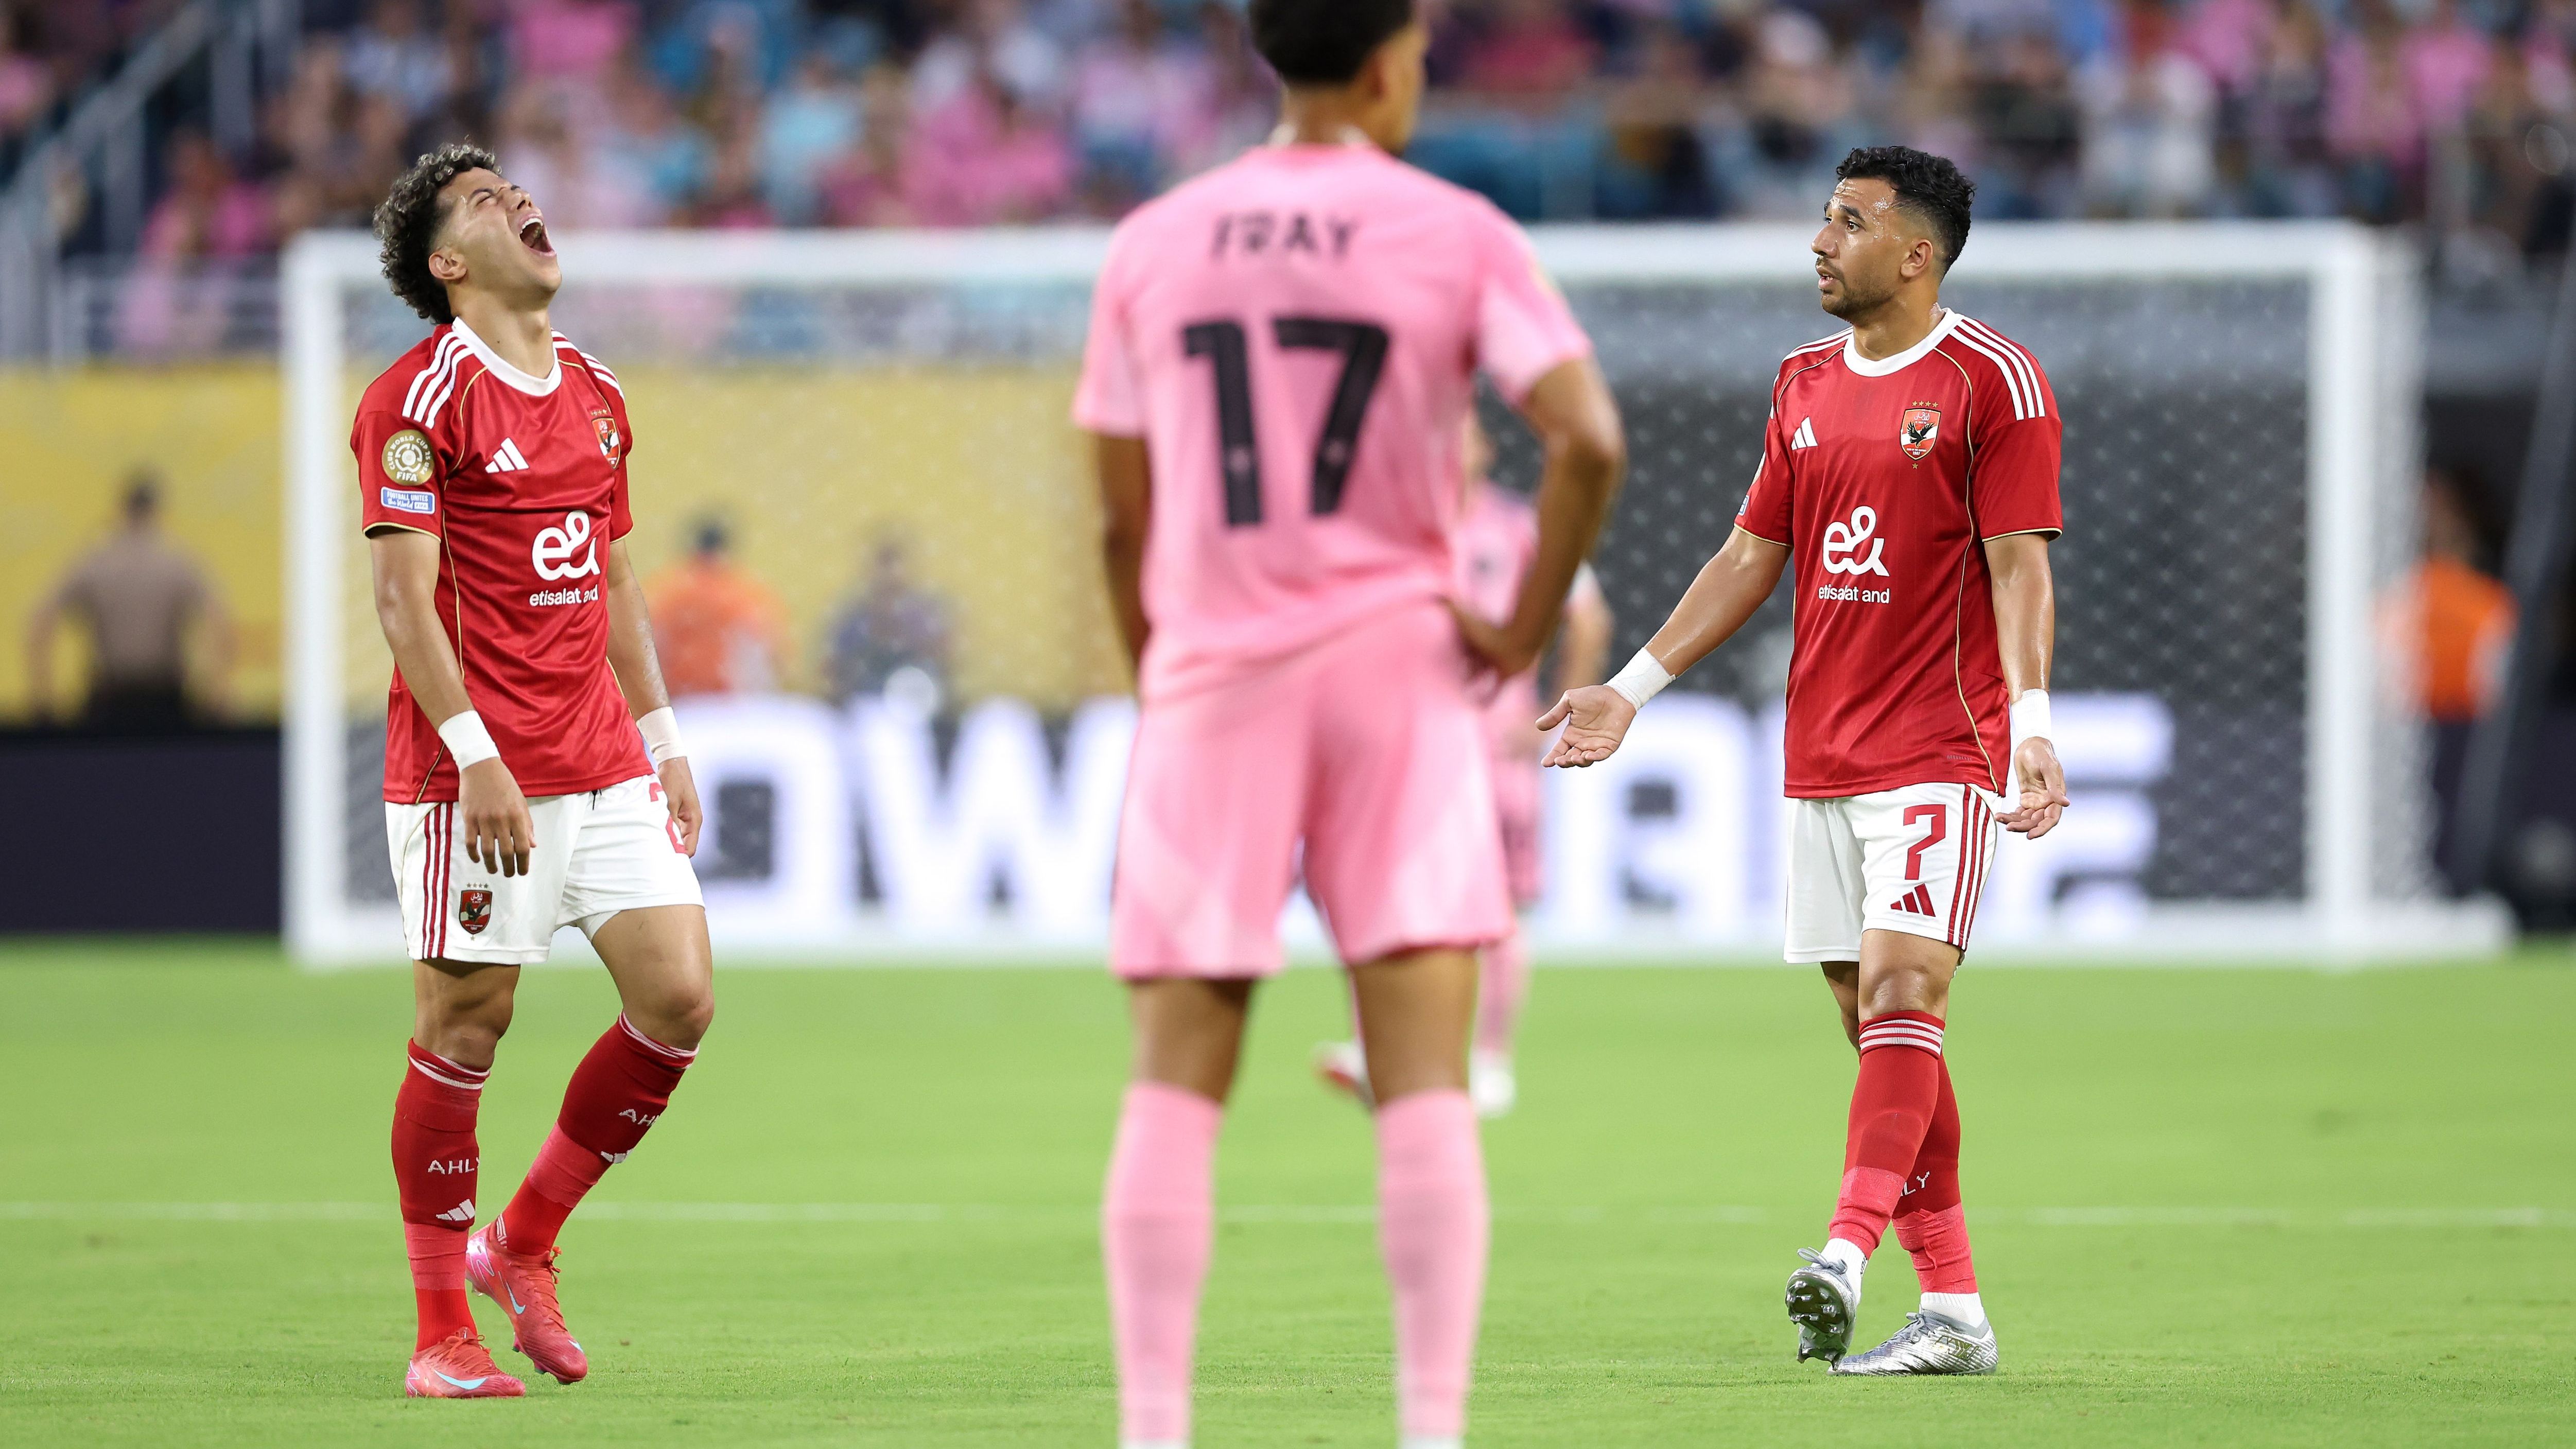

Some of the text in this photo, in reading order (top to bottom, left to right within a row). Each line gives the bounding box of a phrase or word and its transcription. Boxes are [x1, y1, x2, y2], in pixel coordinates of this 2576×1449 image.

[1180, 317, 1390, 528] 17
[390, 435, 414, 450] WORLD
[416, 438, 428, 449] CUP
[387, 451, 395, 470] CLUB
[396, 471, 417, 482] FIFA
[387, 491, 409, 500] FOOTBALL
[529, 588, 582, 606] etisalat
[1818, 584, 1890, 604] etisalat and
[1903, 804, 1946, 881] 7
[1901, 1171, 1930, 1197] LY
